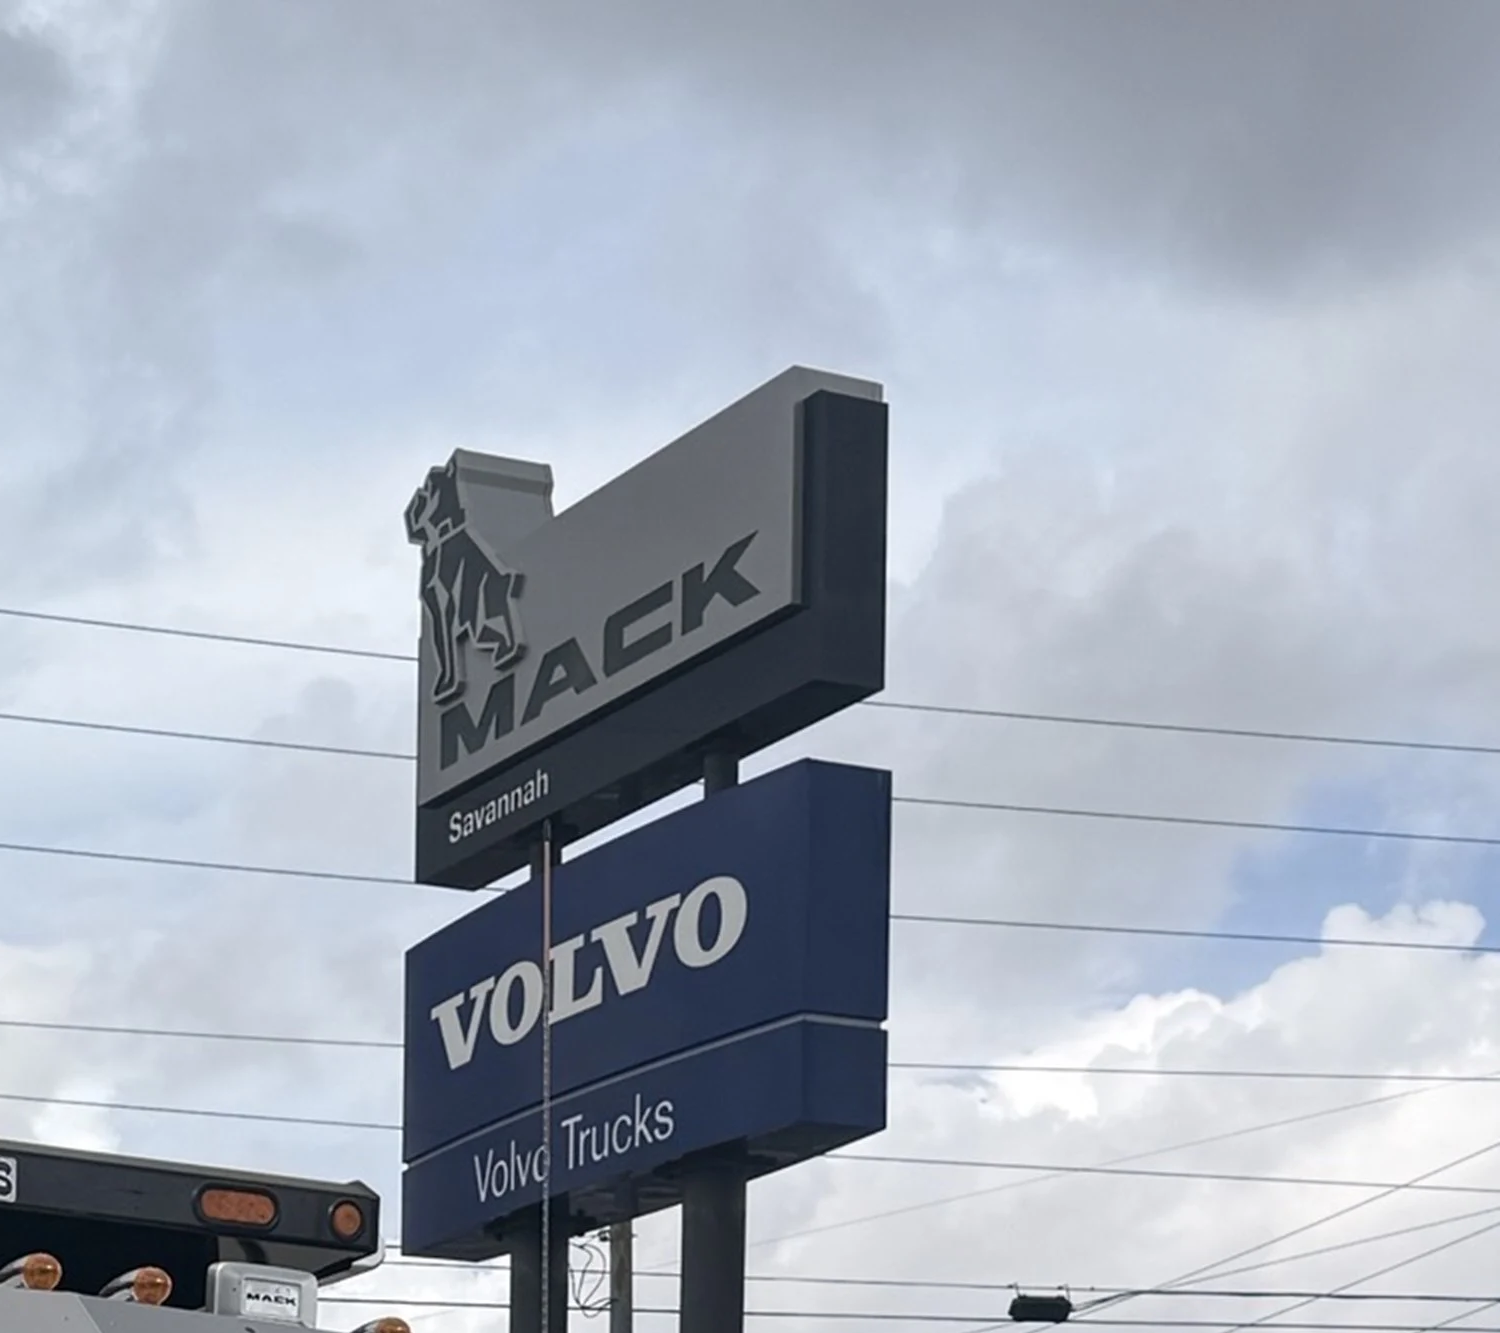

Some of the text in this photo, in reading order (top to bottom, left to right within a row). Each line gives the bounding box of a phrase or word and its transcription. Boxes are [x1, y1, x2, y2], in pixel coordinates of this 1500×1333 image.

[440, 530, 761, 770] MACK
[448, 769, 550, 843] Savannah
[430, 876, 747, 1070] VOLVO
[473, 1094, 675, 1202] Volvo Trucks
[246, 1293, 297, 1307] MACK
